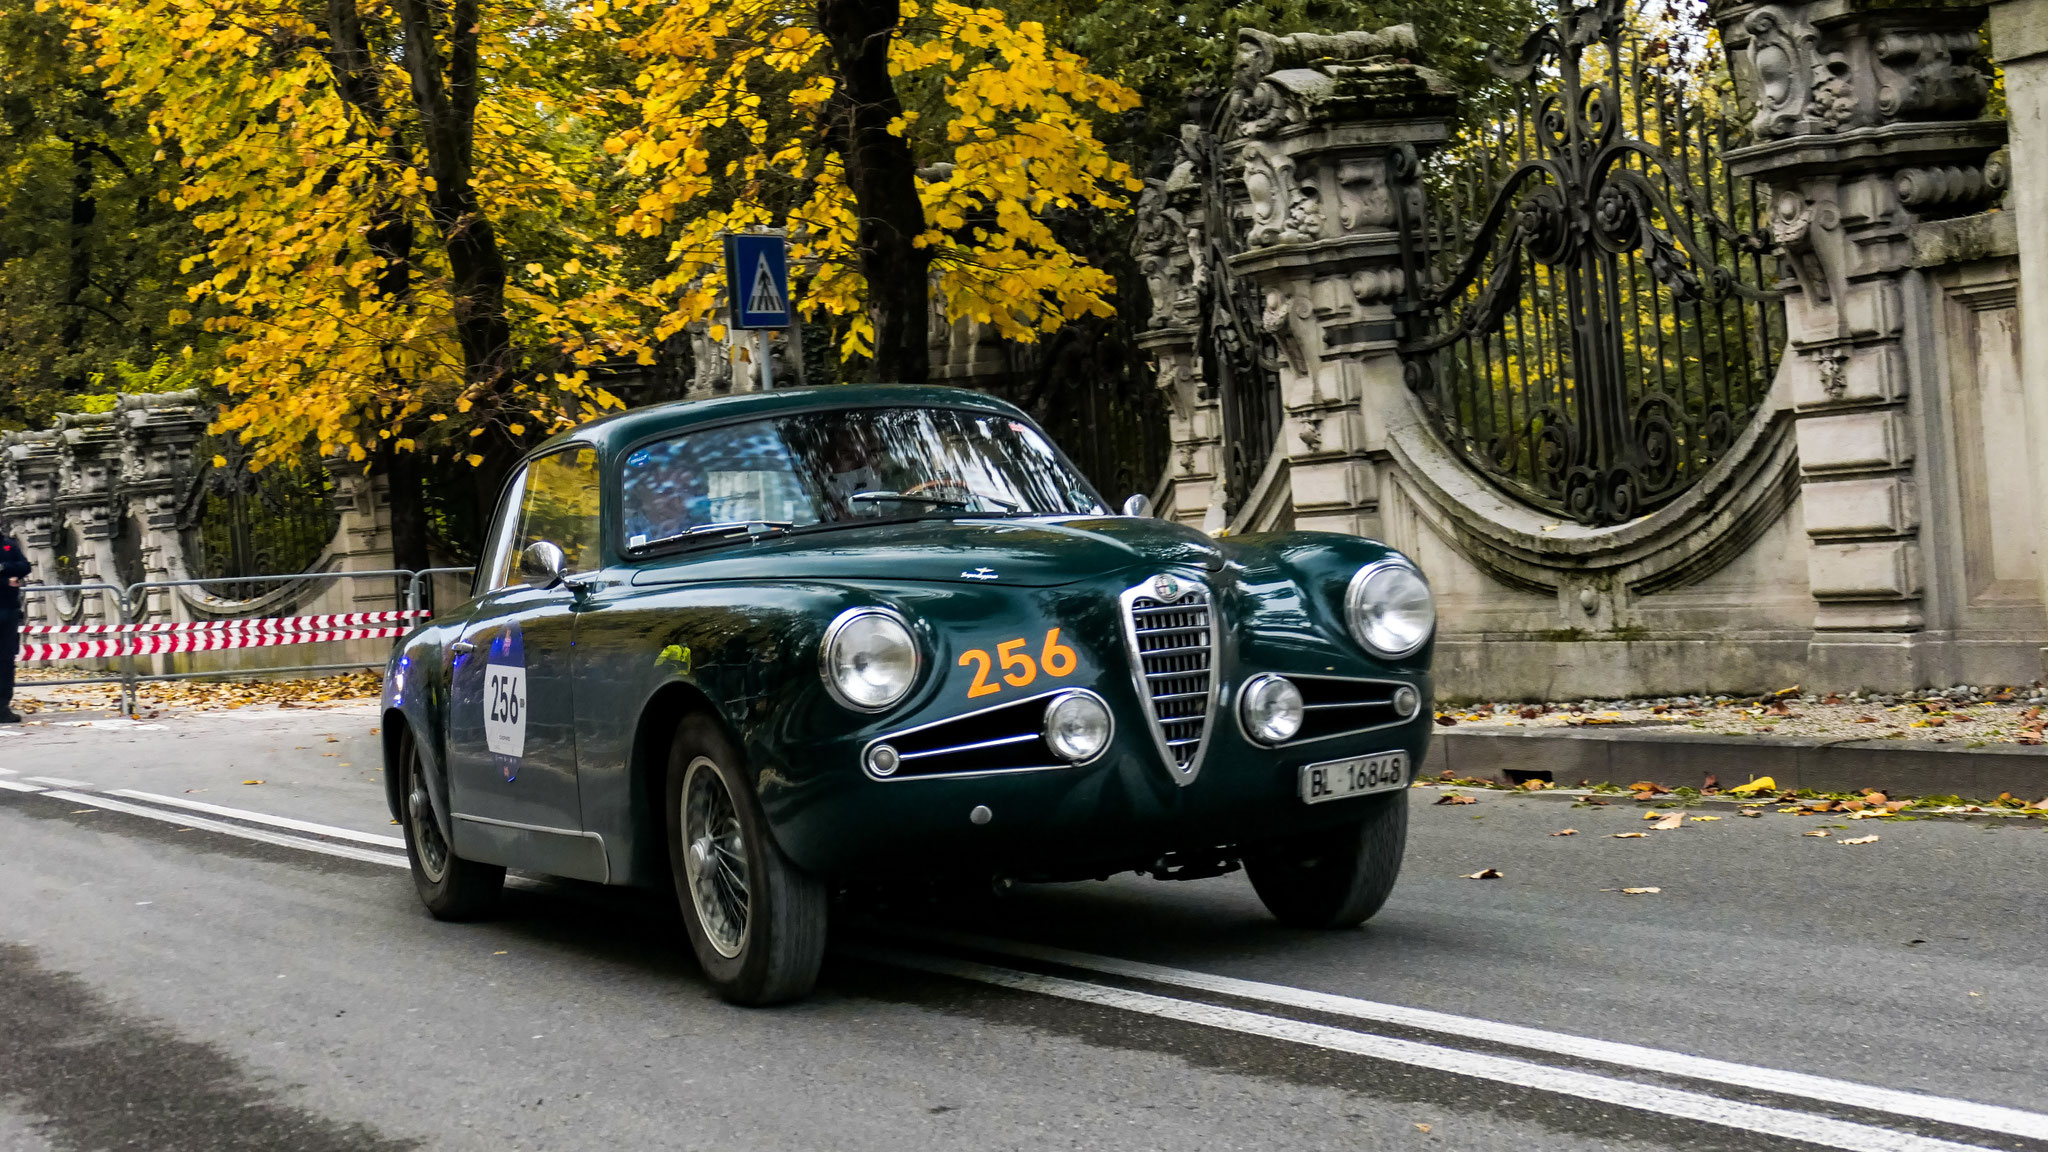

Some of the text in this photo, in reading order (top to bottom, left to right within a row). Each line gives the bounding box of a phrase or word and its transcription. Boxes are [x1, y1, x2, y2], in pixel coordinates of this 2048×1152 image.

[958, 627, 1077, 698] 256
[491, 674, 518, 724] 256
[1312, 757, 1401, 797] BL 16848
